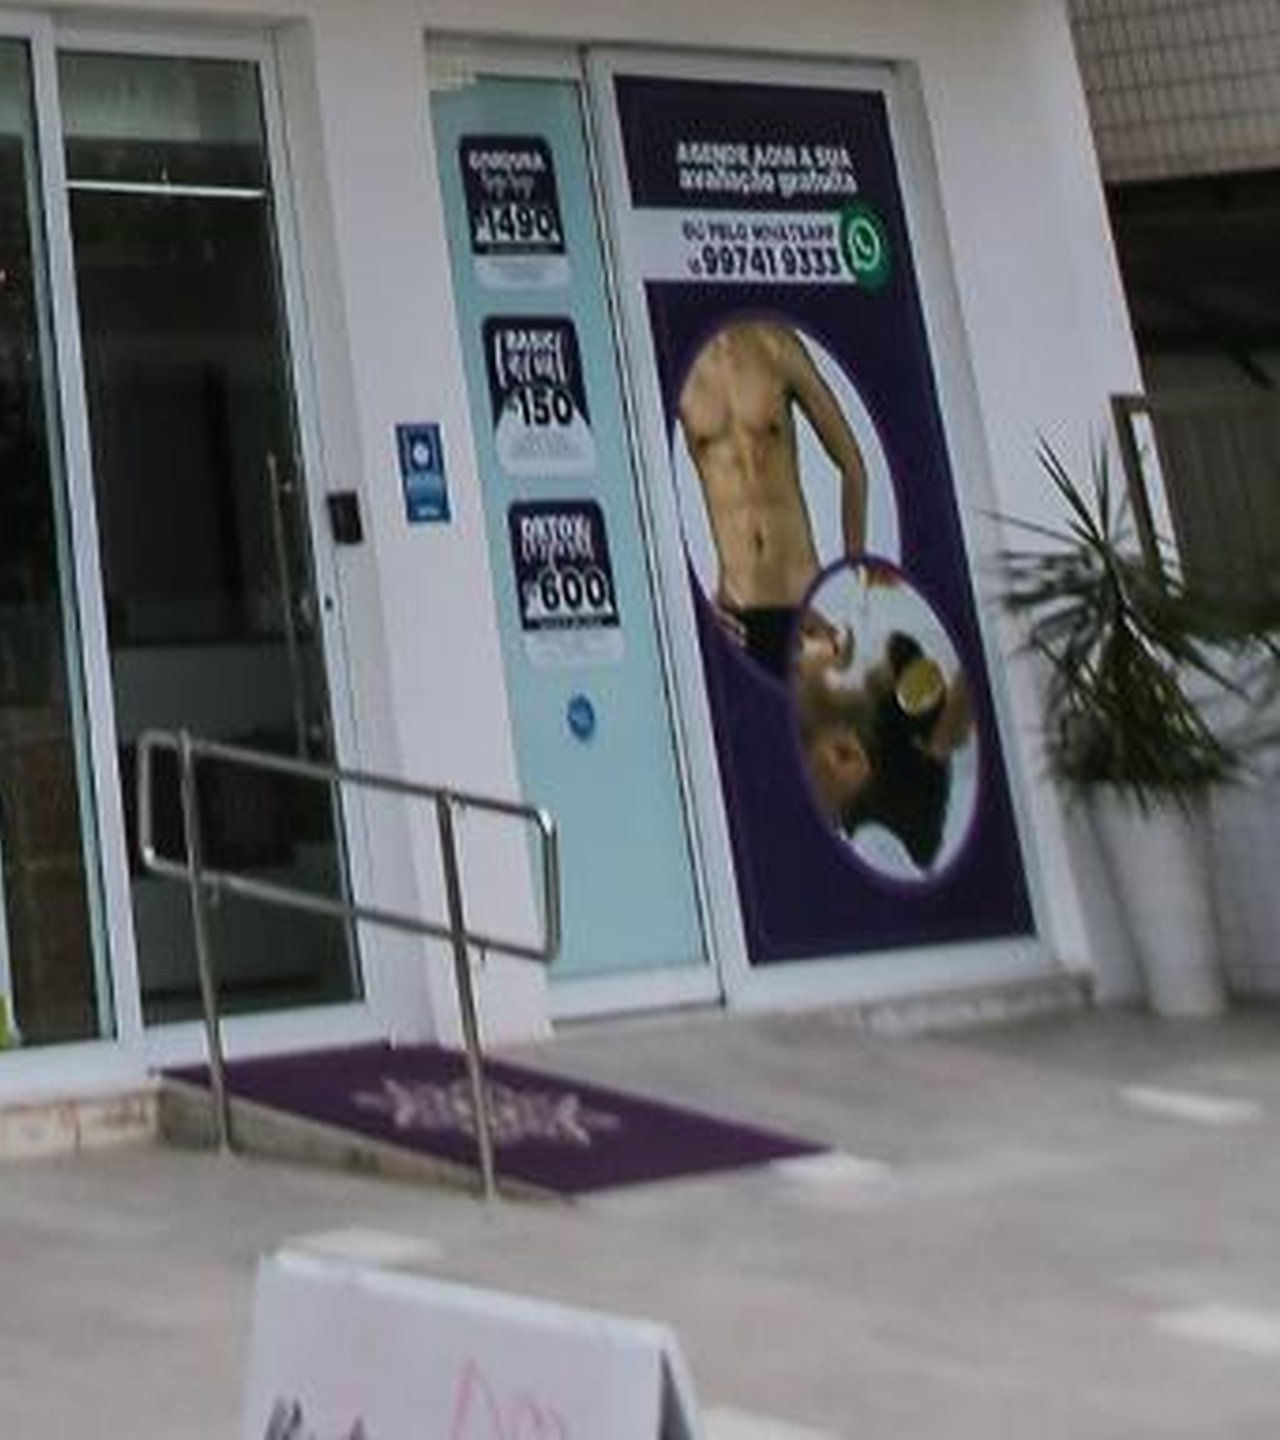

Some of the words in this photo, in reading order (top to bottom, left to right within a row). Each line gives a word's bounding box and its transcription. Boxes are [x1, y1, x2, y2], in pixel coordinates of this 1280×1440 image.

[702, 244, 776, 276] 99741
[780, 245, 840, 276] 9333
[540, 569, 607, 611] 600
